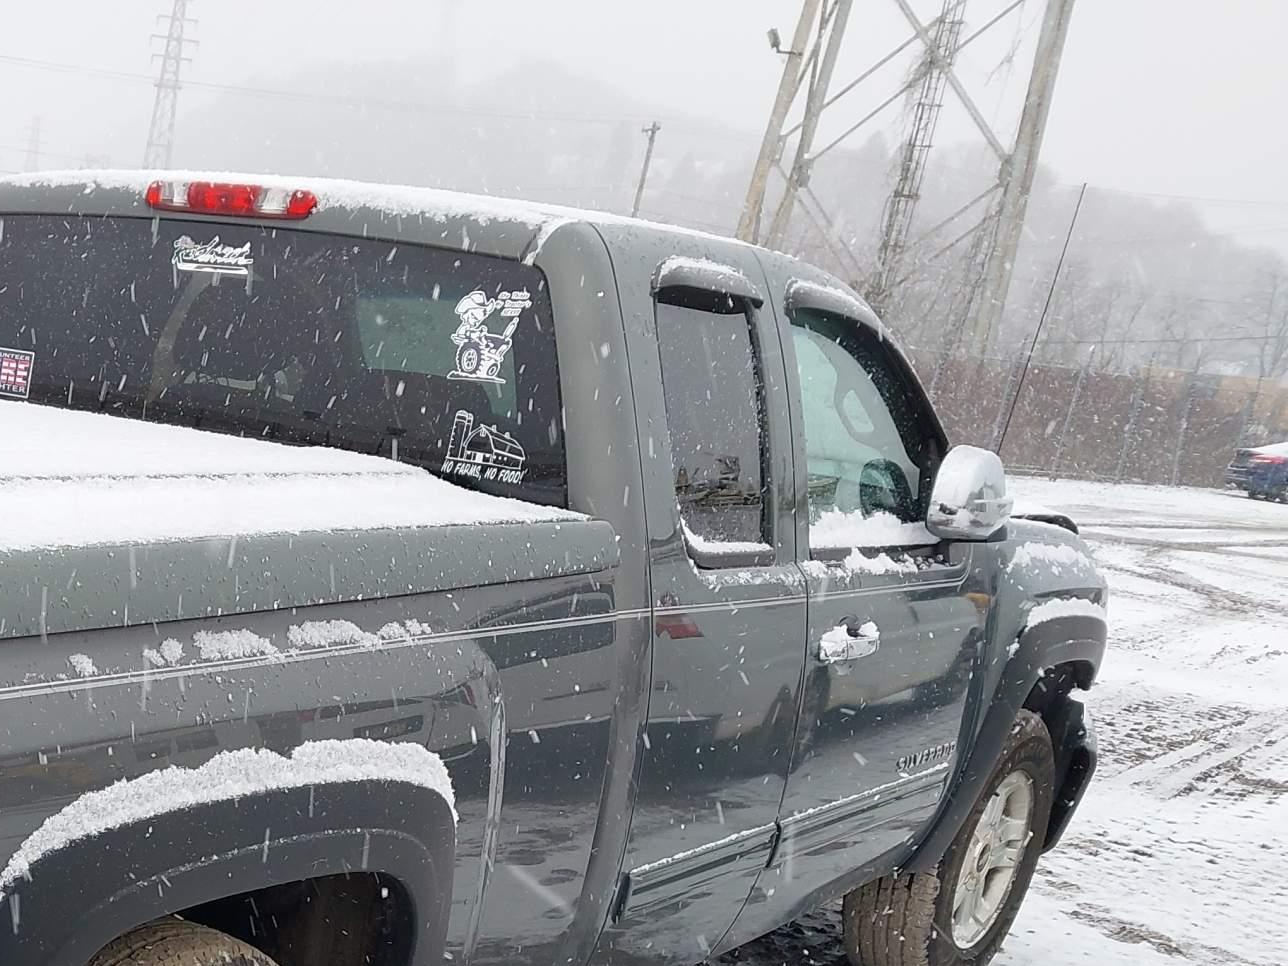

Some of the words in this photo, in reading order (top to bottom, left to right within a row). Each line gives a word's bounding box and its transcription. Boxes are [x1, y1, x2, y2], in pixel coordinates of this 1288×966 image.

[441, 460, 454, 473] NO
[454, 462, 482, 481] FARMS,
[484, 467, 498, 480] NO
[498, 470, 524, 485] FOOD!
